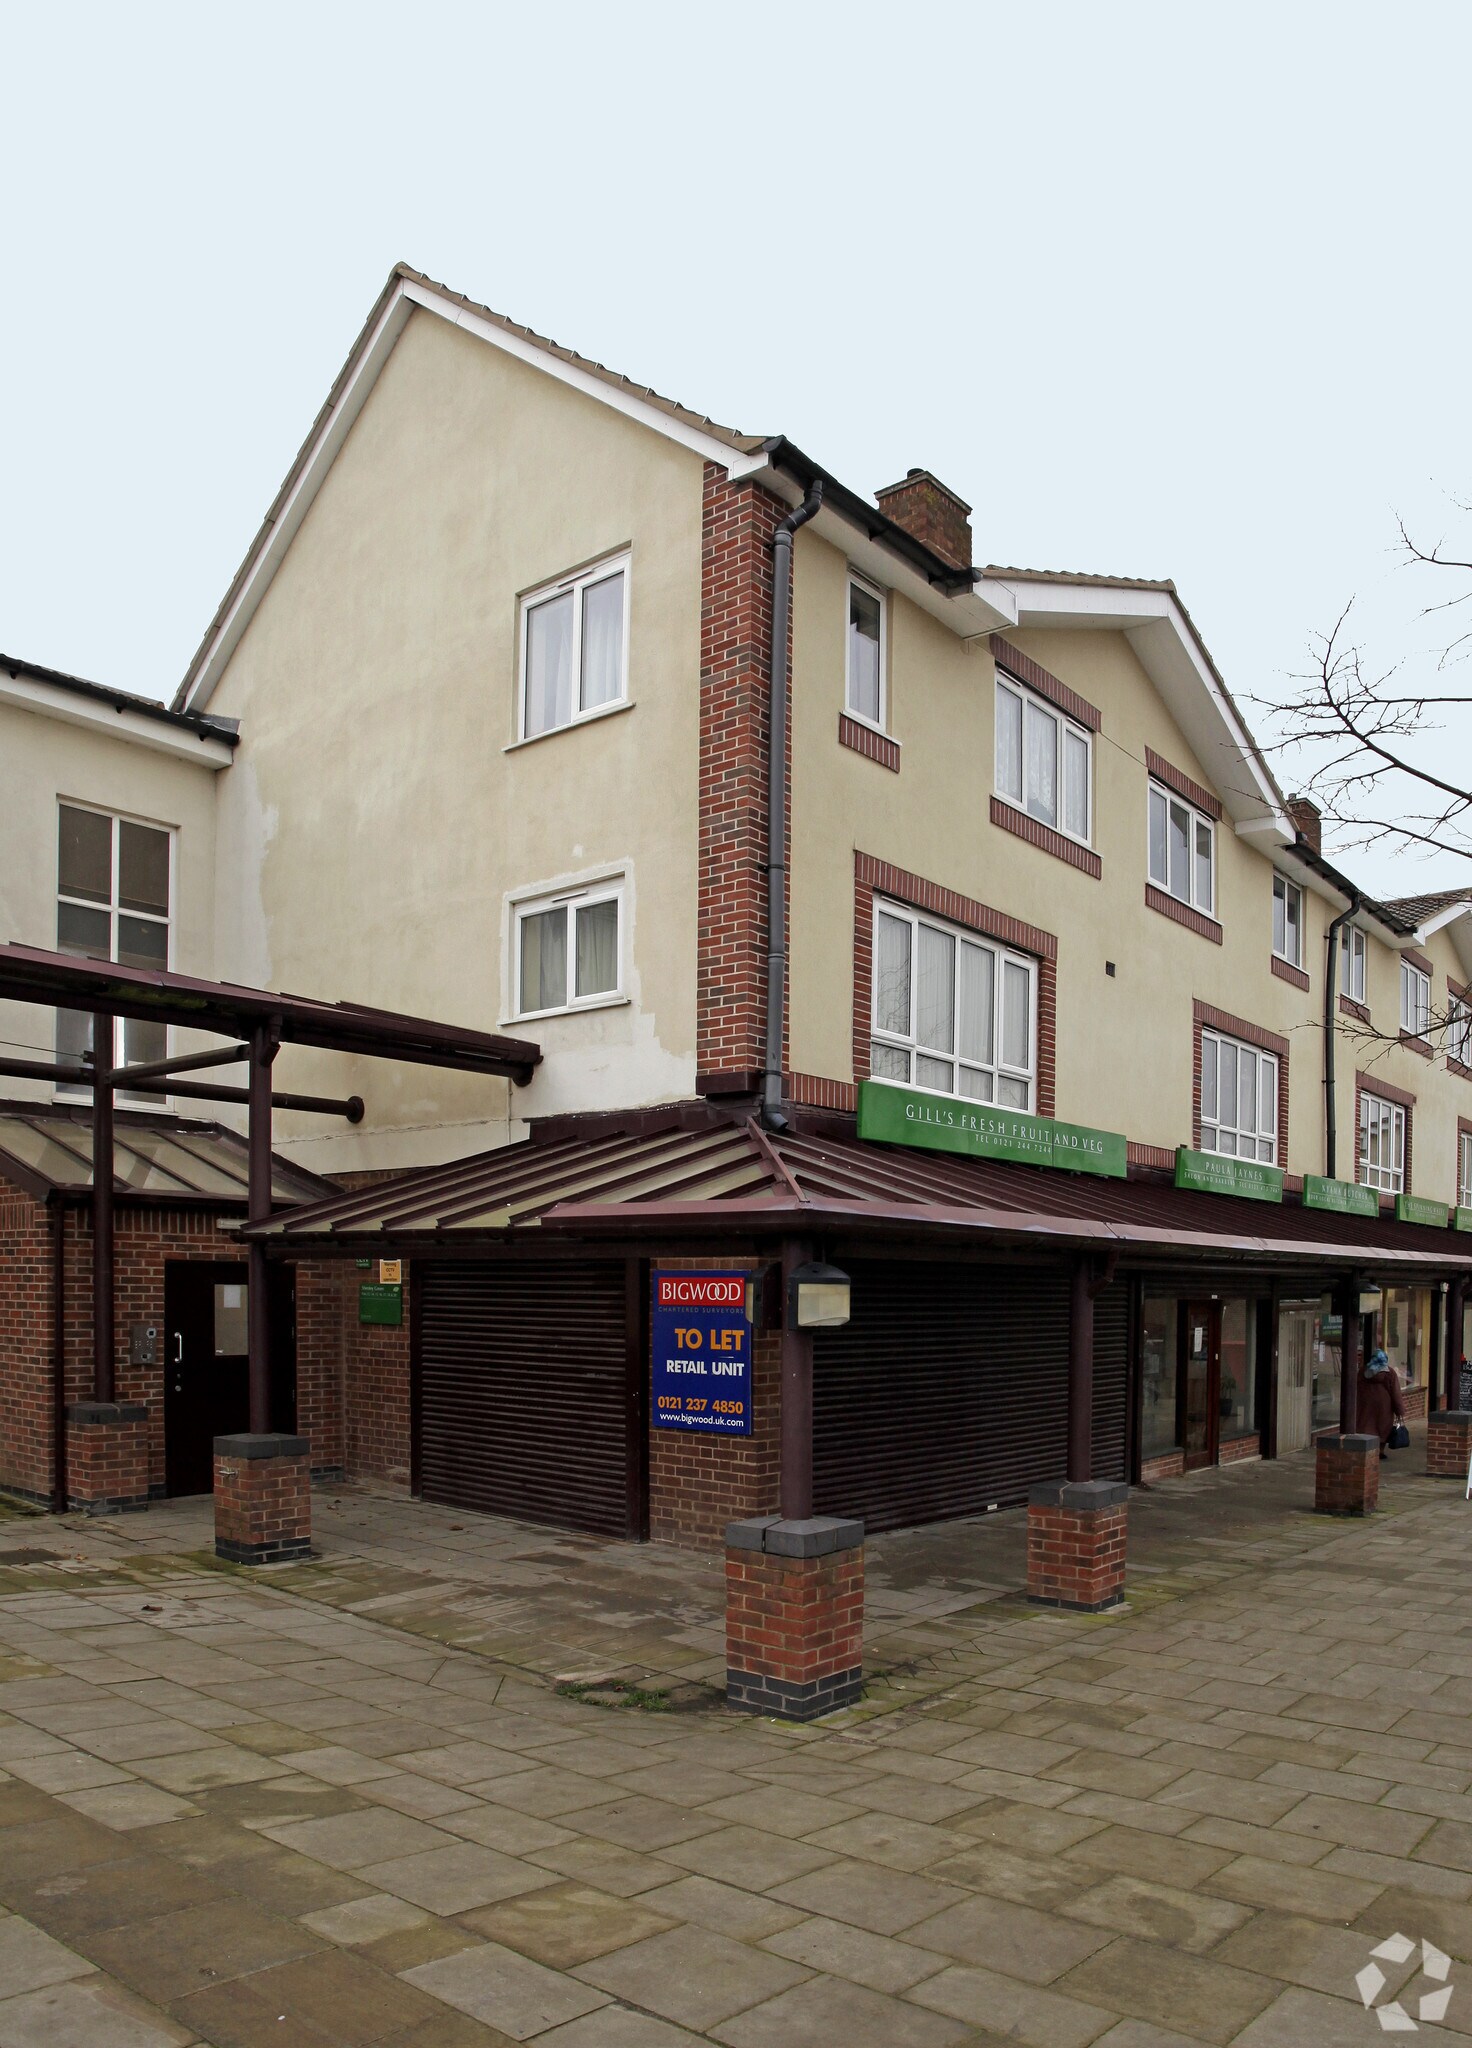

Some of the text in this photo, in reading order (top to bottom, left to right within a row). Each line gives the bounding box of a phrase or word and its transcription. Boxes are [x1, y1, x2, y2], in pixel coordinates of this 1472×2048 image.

[905, 1104, 1103, 1152] GILL'S FRESH FRUIT AND VEG
[975, 1133, 989, 1143] TEL
[993, 1137, 1012, 1147] 0121
[1205, 1161, 1263, 1181] PAULA JAYNES
[662, 1282, 741, 1301] BIGWOOD
[702, 1307, 744, 1315] SURVEYORS
[674, 1328, 745, 1351] TO LET
[666, 1360, 745, 1377] RETAIL UNIT
[657, 1396, 744, 1414] 0121 237 4850
[659, 1413, 744, 1428] www.bigwood.uk.com
